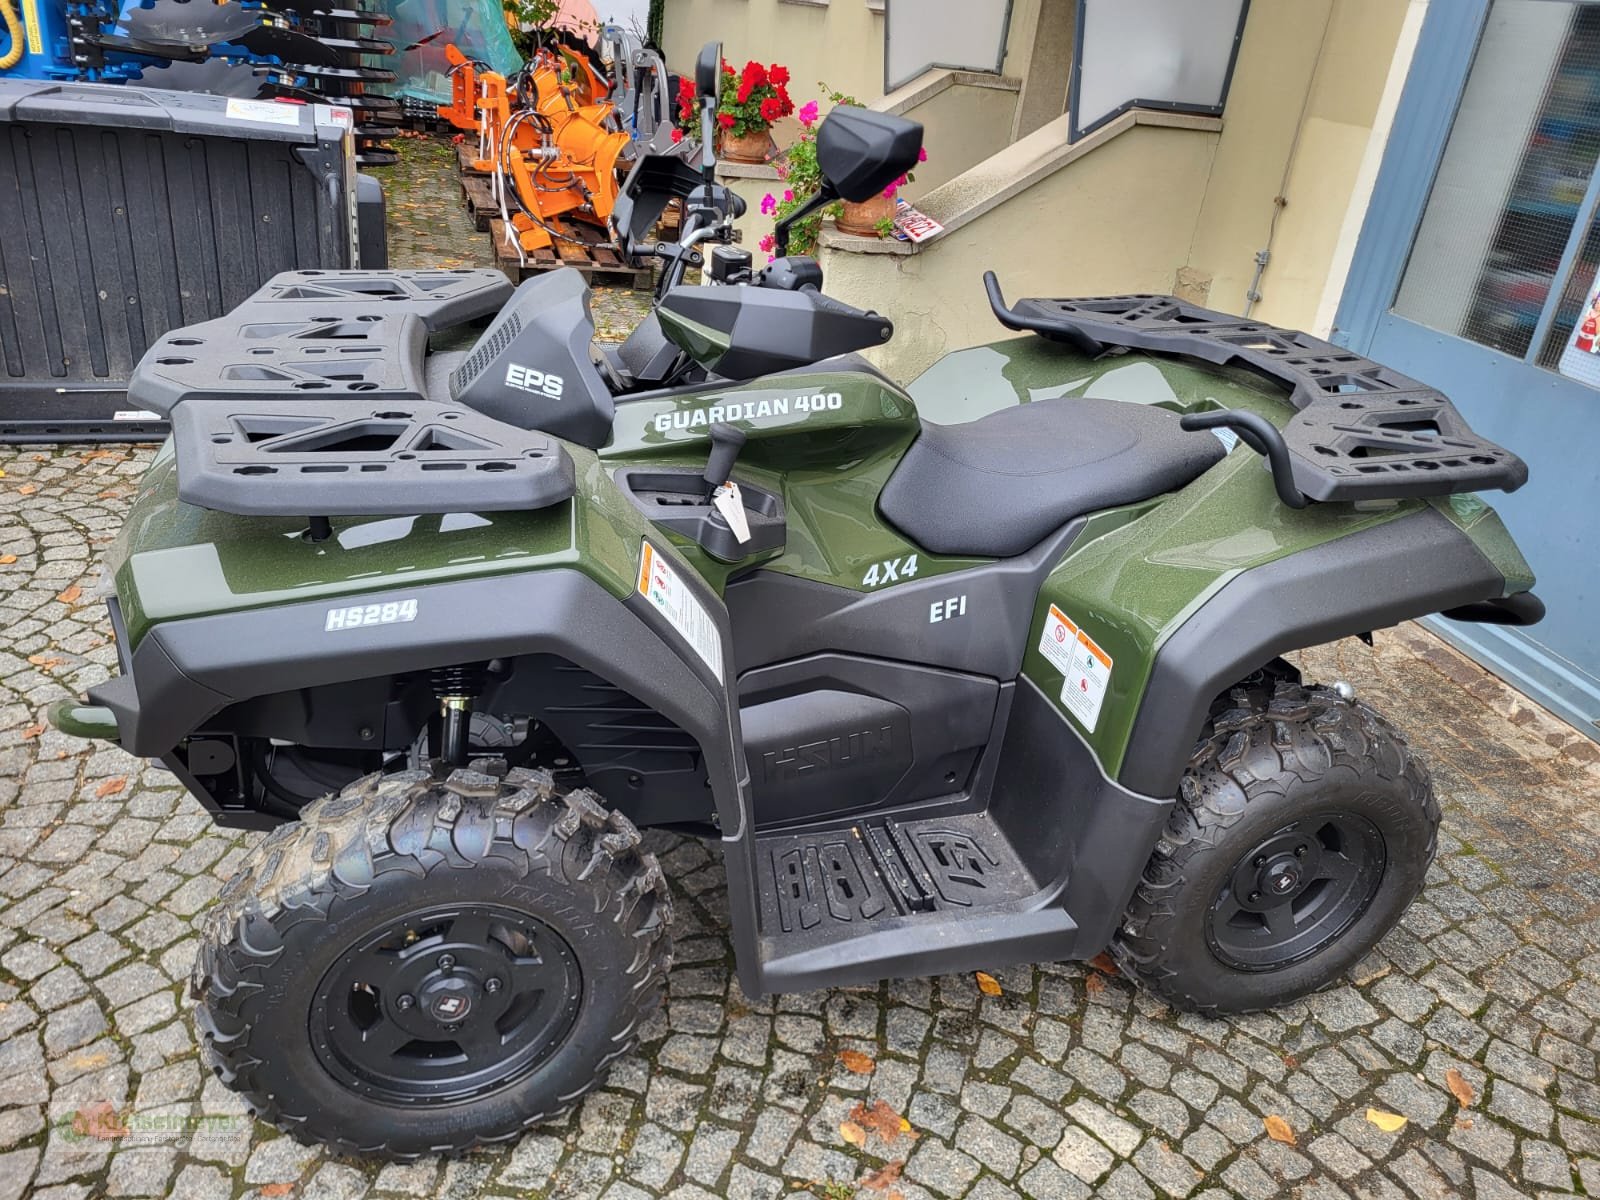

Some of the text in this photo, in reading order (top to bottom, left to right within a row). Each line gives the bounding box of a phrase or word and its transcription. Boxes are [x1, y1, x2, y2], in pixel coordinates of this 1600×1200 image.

[506, 363, 564, 396] EPS
[655, 392, 842, 432] GUARDIAN 400
[862, 554, 918, 587] 4X4
[326, 599, 418, 631] HS284
[929, 595, 967, 624] EFI
